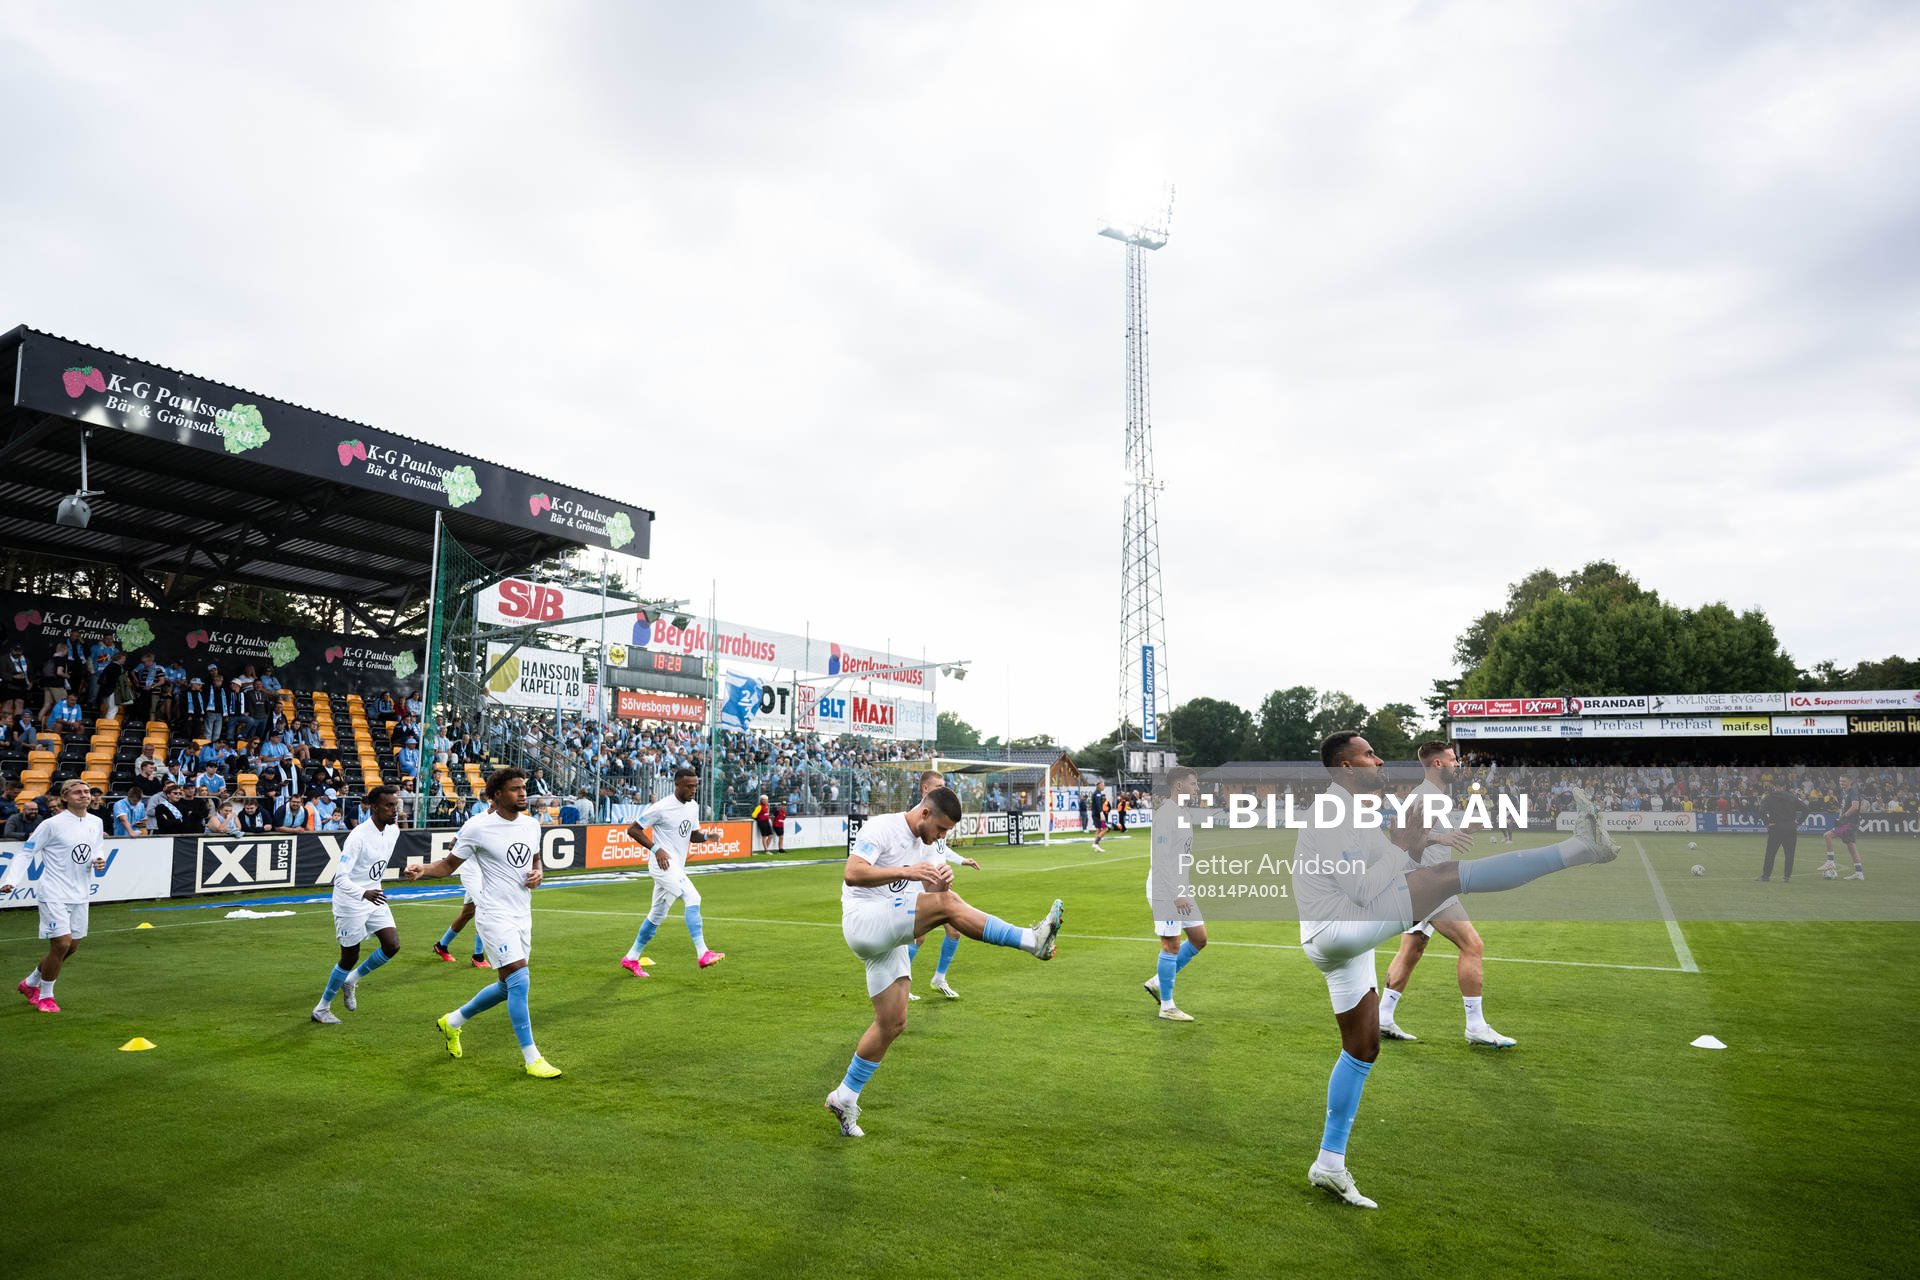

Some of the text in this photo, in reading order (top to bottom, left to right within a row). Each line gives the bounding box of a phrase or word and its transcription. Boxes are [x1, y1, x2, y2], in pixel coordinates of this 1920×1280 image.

[106, 372, 247, 426] K-G Paulssons
[104, 395, 135, 414] Bär
[138, 403, 152, 418] &
[157, 408, 229, 439] Grönsaker
[366, 444, 465, 481] K-G Paulssons
[366, 462, 387, 478] Bär
[388, 468, 398, 481] &
[550, 496, 574, 514] K-G
[550, 512, 566, 525] Bär
[566, 517, 574, 527] &
[497, 579, 564, 622] SVB
[41, 625, 62, 637] Bär
[42, 611, 139, 633] K-G Paulssons
[207, 643, 225, 654] Bär
[225, 645, 233, 655] &
[208, 630, 288, 650] K-G Paulssons
[342, 658, 356, 668] Bär
[343, 646, 408, 663] K-G Paulssons
[653, 653, 682, 672] 18:28
[521, 660, 580, 682] HANSSON
[1146, 649, 1154, 693] GRUPPEN
[520, 677, 580, 697] KAPELL AB
[621, 697, 671, 715] Sölvesborg
[819, 697, 846, 719] BLT
[1583, 699, 1646, 709] BRANDAB
[1676, 693, 1782, 706] KYLINGE BYGG AB
[1790, 696, 1873, 707] ICA Supermarket
[852, 696, 894, 726] MAXI
[1484, 725, 1552, 733] MMGMARINE.SE
[1593, 719, 1644, 731] PreFast
[1660, 719, 1713, 730] PreFast
[1722, 720, 1769, 732] maif.se
[1850, 716, 1906, 733] Sweden
[1654, 819, 1684, 827] ELCOM
[203, 842, 288, 886] XL
